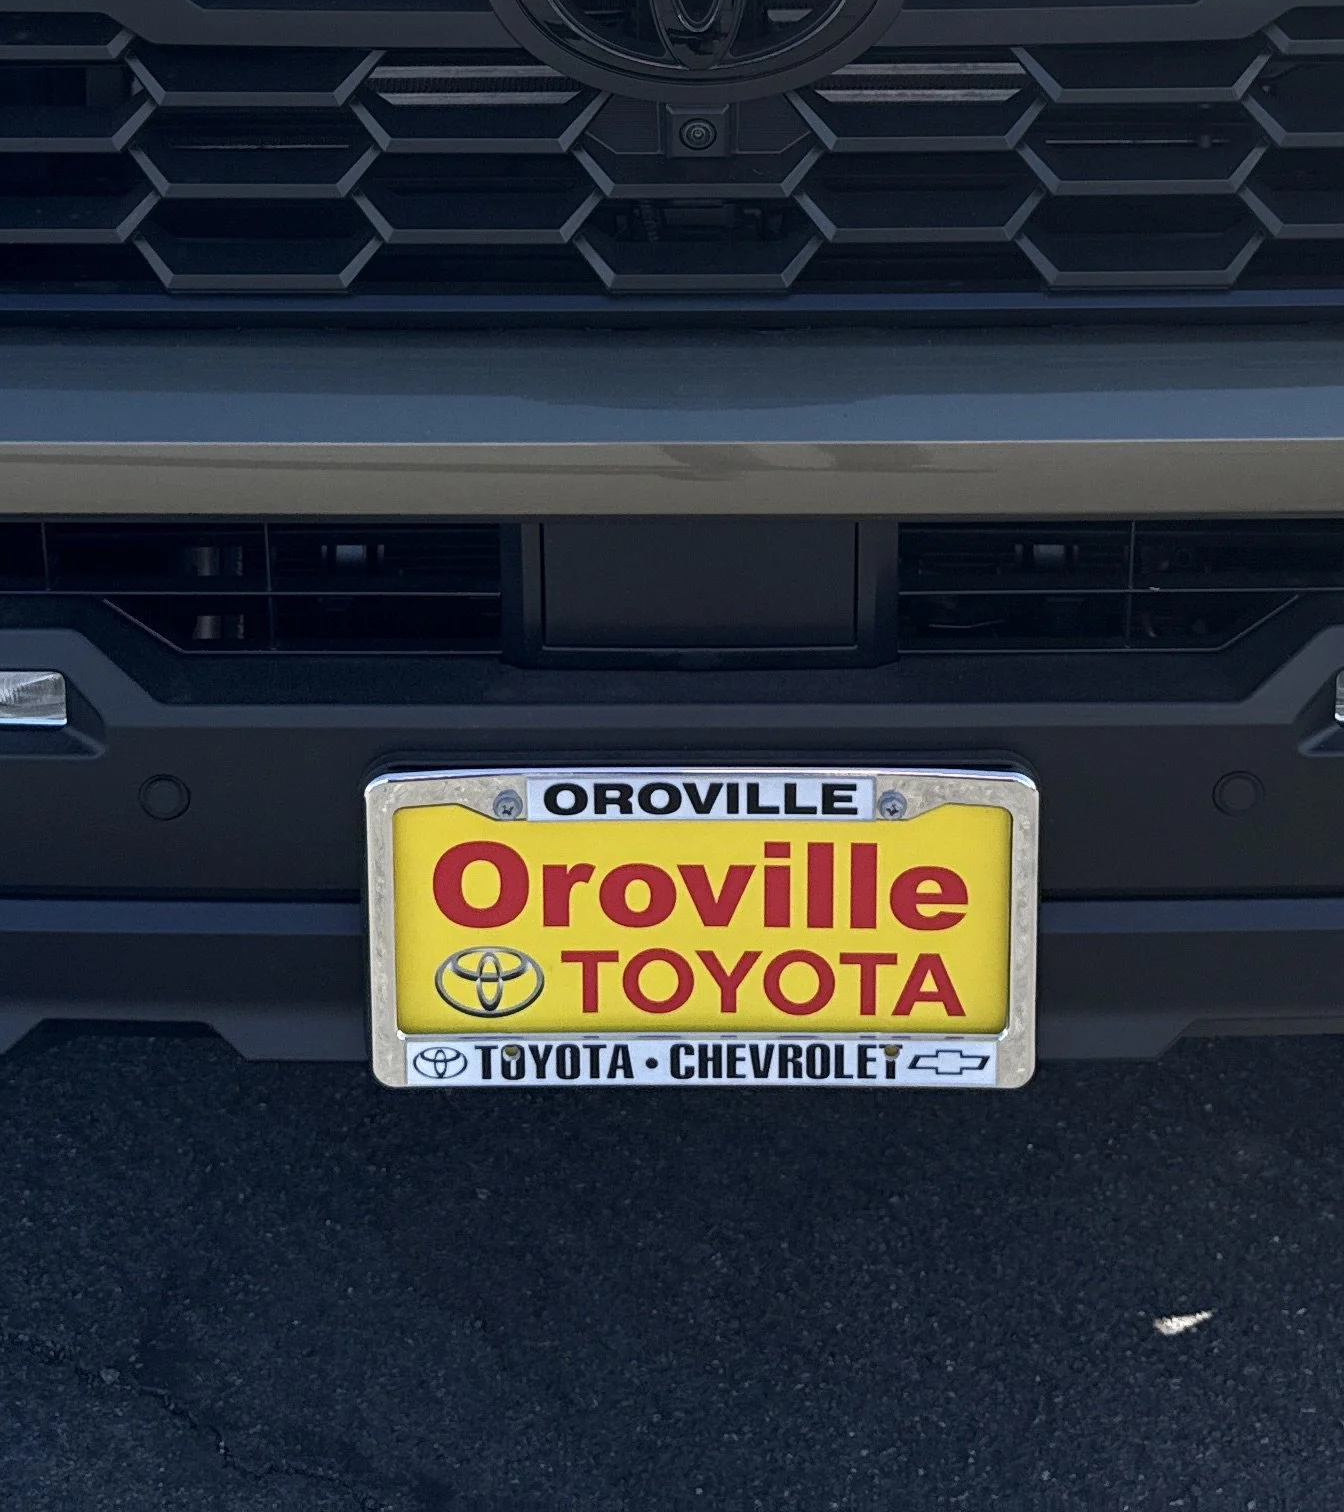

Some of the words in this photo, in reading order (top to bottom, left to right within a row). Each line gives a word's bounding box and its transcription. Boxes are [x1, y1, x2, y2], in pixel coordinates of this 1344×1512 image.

[542, 782, 859, 816] OROVILLE
[431, 840, 969, 931] Oroville
[561, 948, 966, 1017] TOYOTA
[475, 1044, 635, 1080] TOYOTA
[669, 1043, 904, 1080] CHEVROLET
